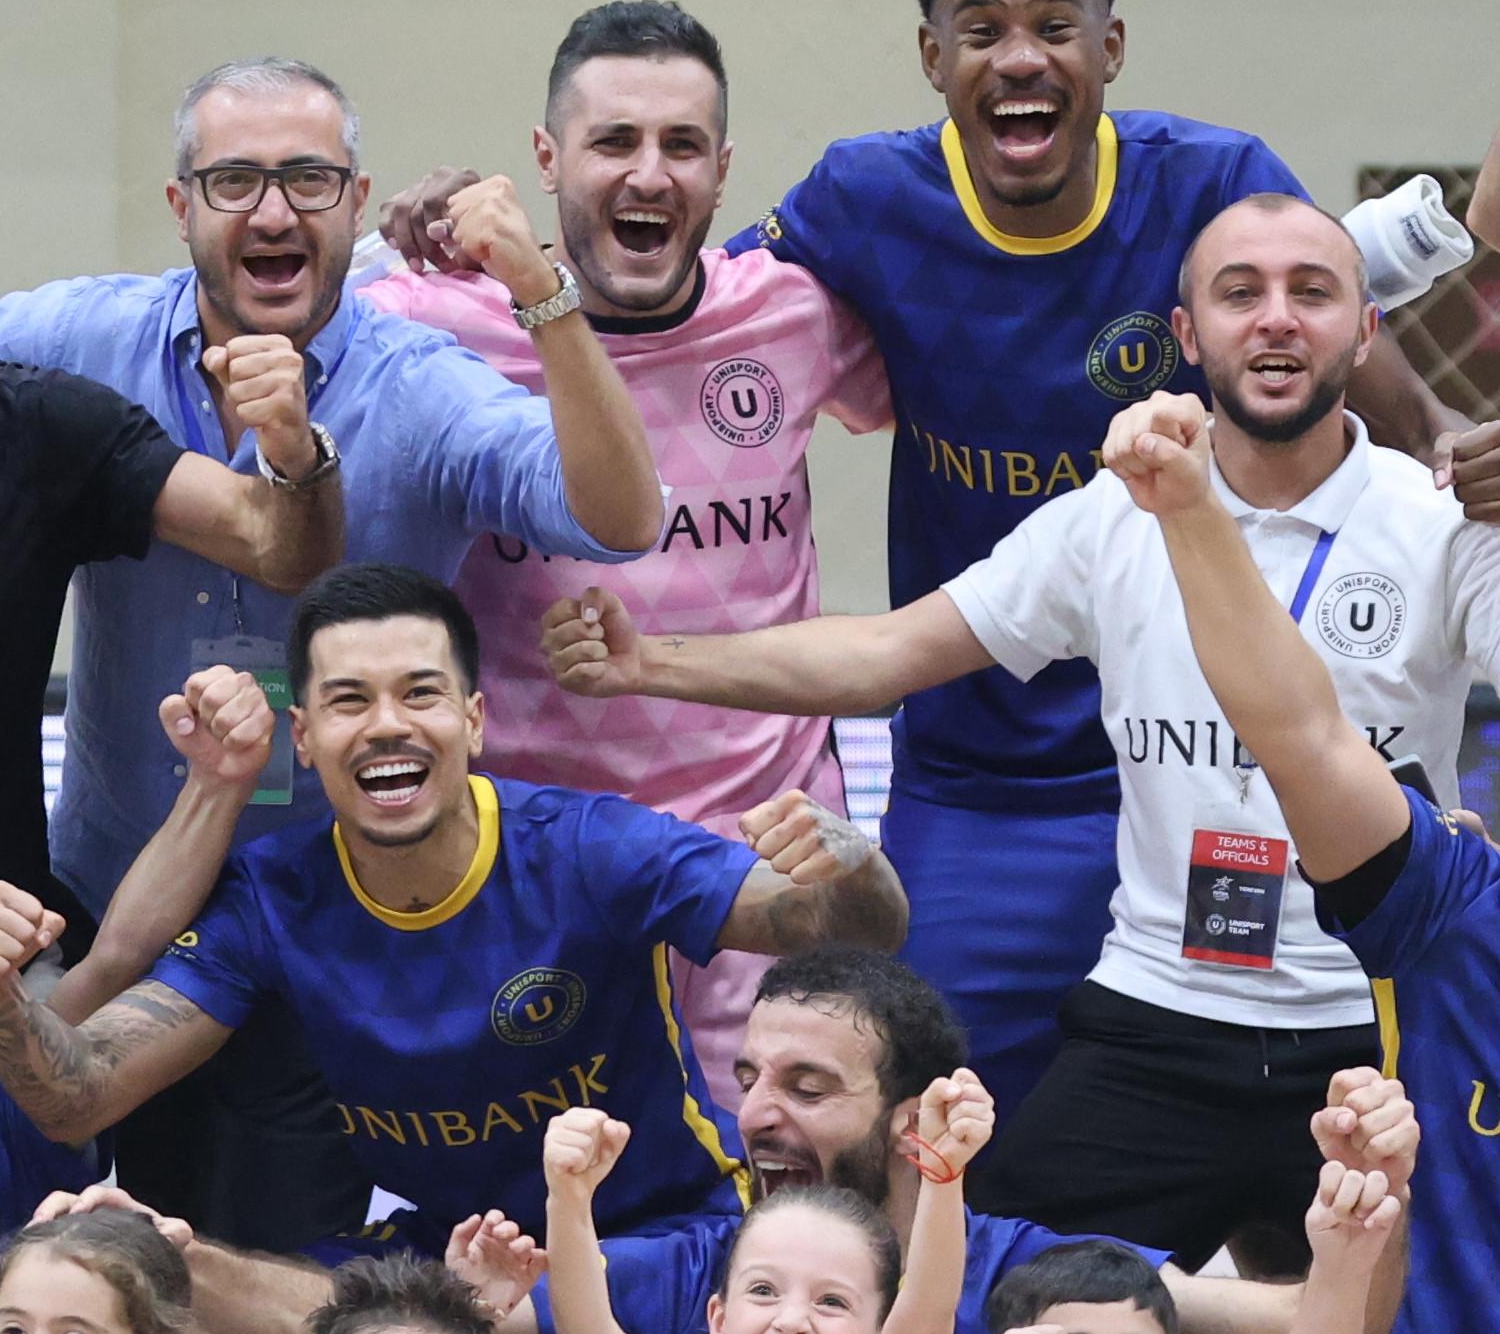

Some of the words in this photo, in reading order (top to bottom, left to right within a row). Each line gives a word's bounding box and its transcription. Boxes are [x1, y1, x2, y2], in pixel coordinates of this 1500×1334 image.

[1119, 342, 1146, 373] U
[712, 363, 767, 384] UNISPORT
[731, 388, 758, 418] U
[1336, 576, 1395, 595] UNISPORT
[1350, 602, 1376, 632] U
[1124, 717, 1404, 766] UNIK
[1217, 836, 1256, 851] TEAMS
[1259, 841, 1268, 852] &
[1212, 849, 1270, 866] OFFICIALS
[525, 997, 553, 1023] U
